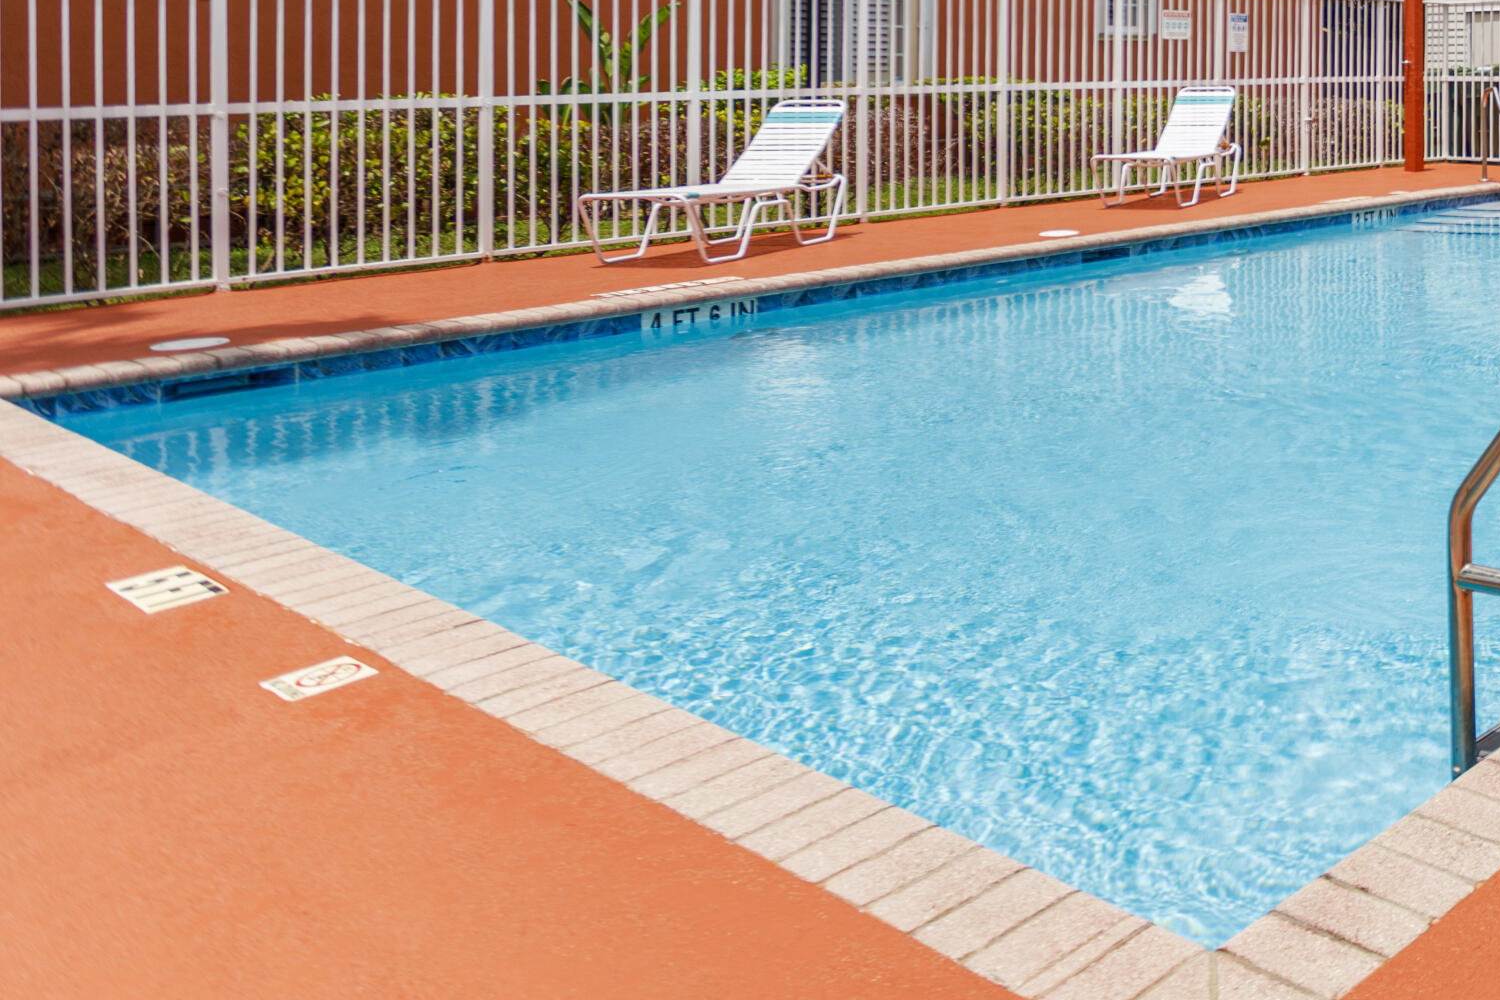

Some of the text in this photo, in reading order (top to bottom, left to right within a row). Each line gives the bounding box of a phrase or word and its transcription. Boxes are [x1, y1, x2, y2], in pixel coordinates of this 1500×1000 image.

[651, 300, 754, 328] 4 FT 6 IN
